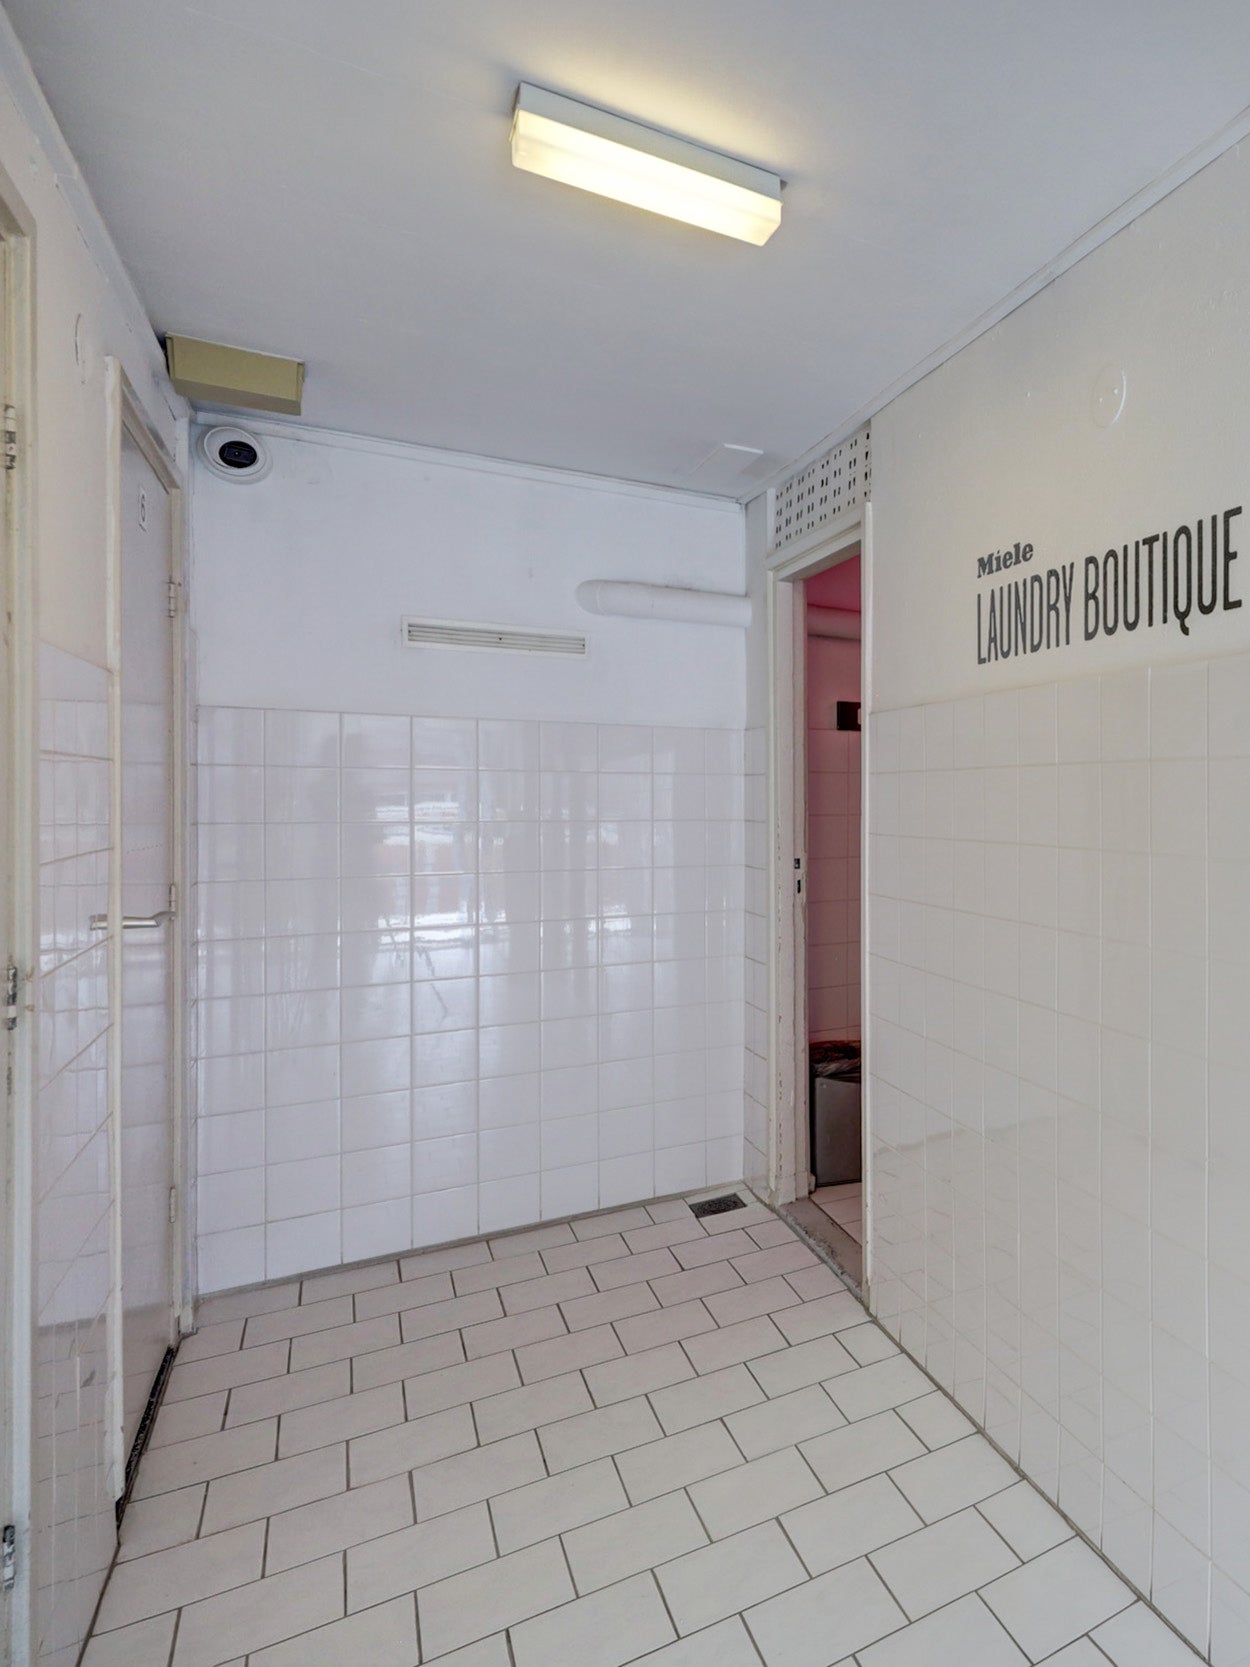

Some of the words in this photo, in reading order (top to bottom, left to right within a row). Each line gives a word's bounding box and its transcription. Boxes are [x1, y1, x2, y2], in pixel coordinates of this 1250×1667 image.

[976, 542, 1034, 578] Miele
[976, 562, 1075, 665] LAUNDRY
[1084, 505, 1243, 641] BOUTIQUE
